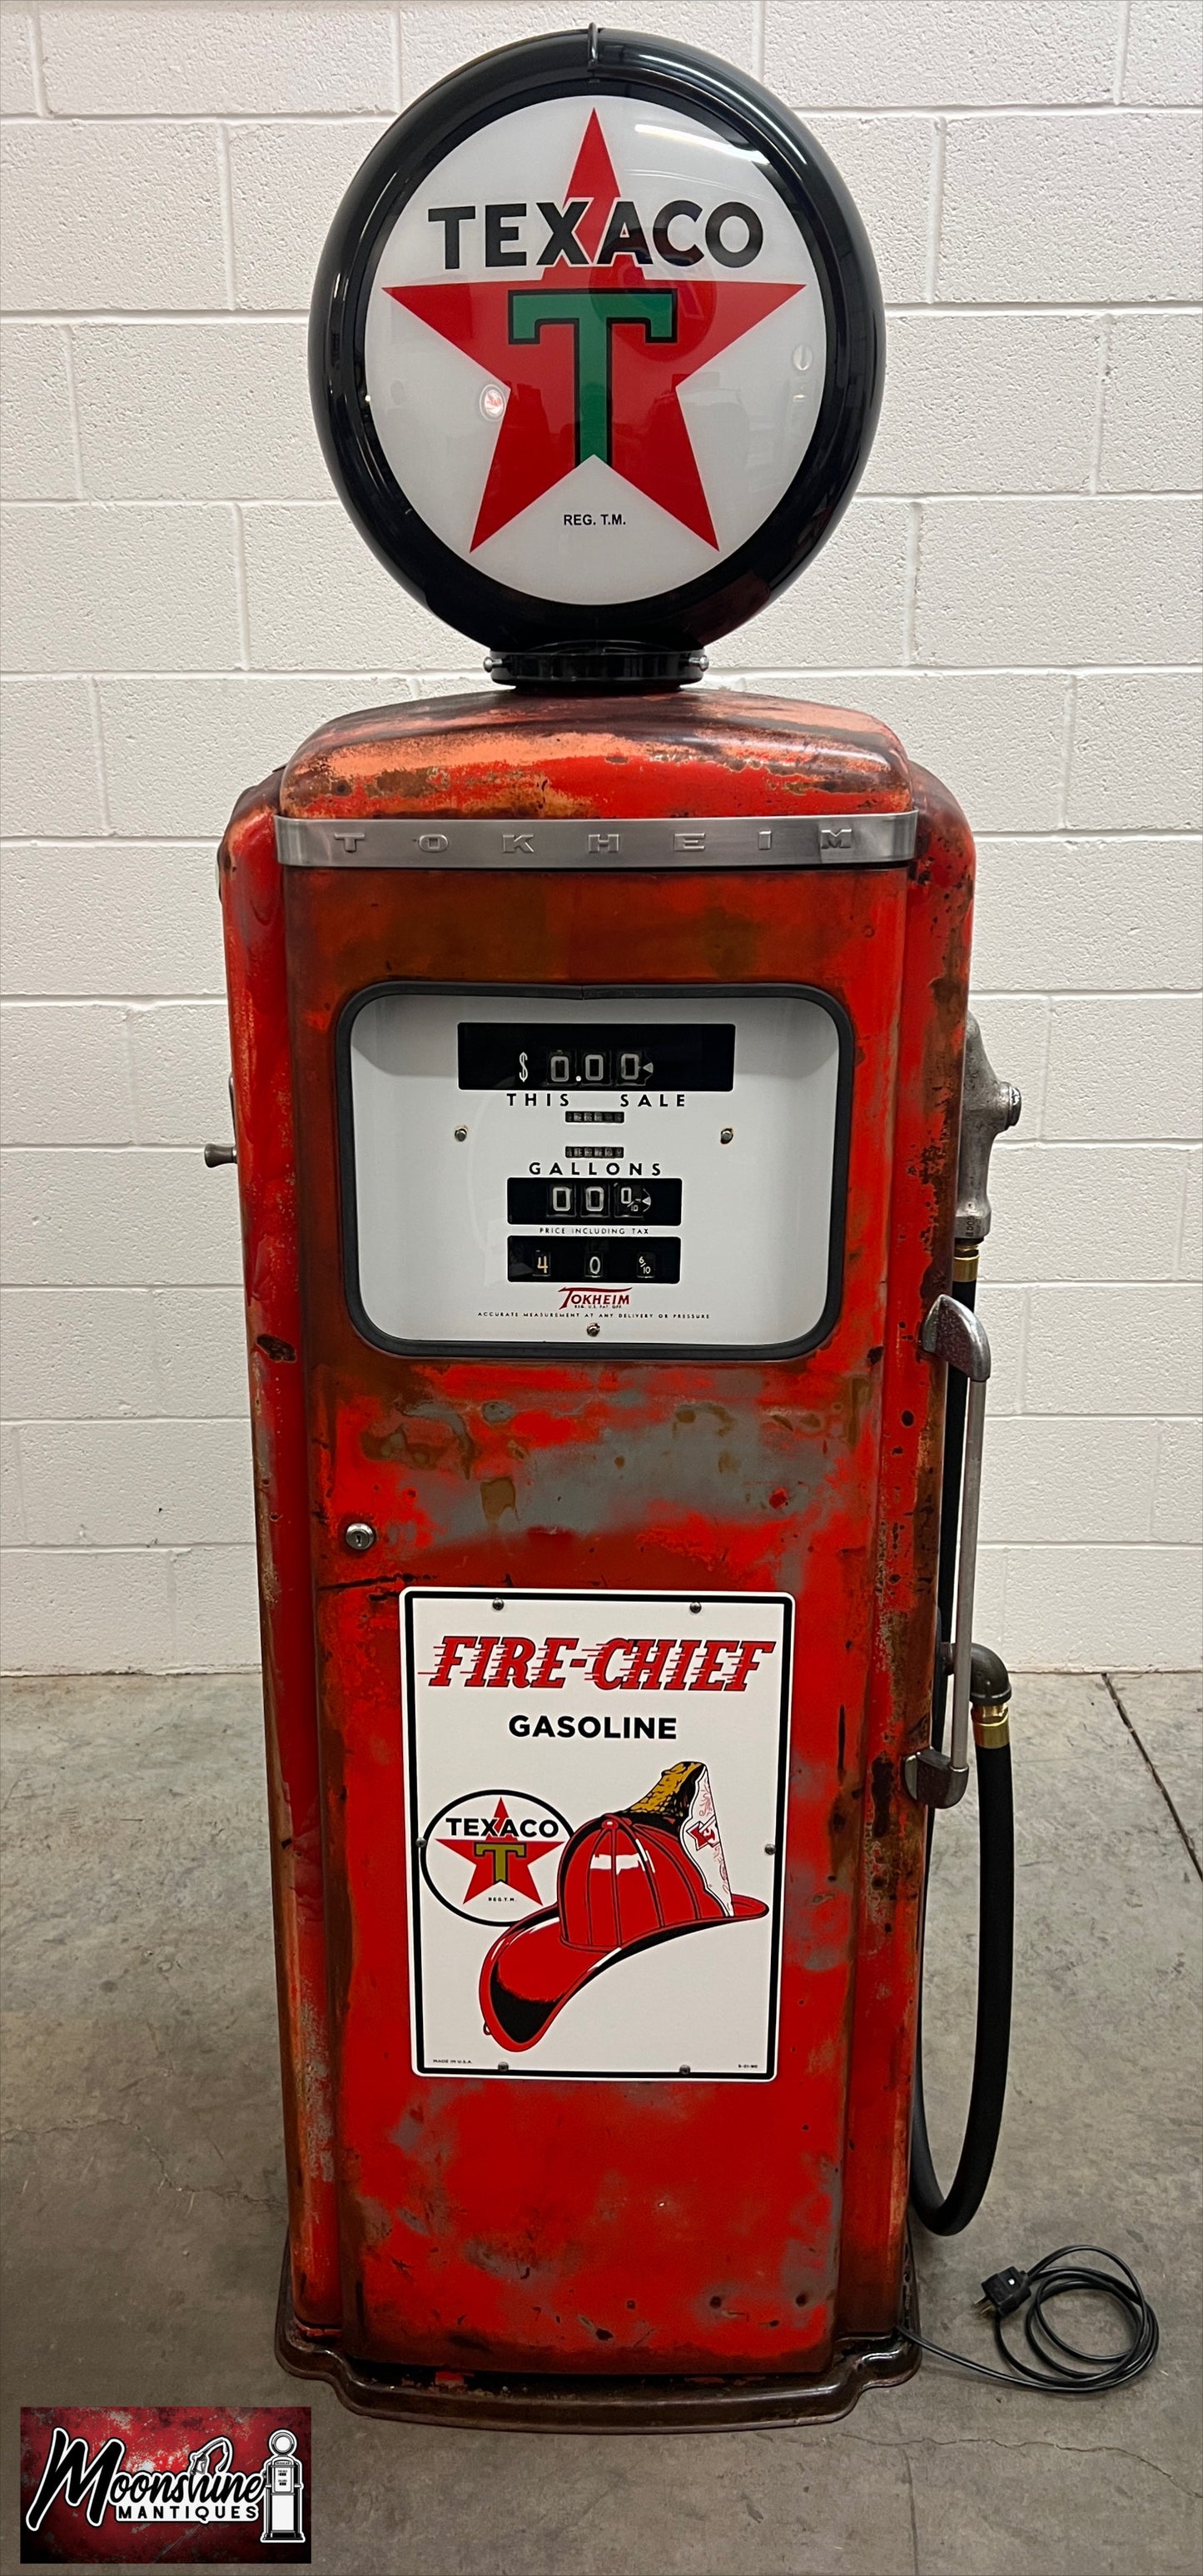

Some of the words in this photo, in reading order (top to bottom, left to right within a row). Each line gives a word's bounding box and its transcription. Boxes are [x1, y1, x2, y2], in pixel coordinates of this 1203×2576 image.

[427, 200, 763, 271] TEXACO
[508, 288, 679, 469] T
[564, 514, 596, 525] REG.
[600, 514, 626, 525] T.M.
[334, 828, 853, 853] TOKHEIM
[519, 1052, 528, 1082] $
[507, 1093, 569, 1107] THIS
[619, 1093, 686, 1108] SALE
[529, 1161, 661, 1176] GALLONS
[537, 1256, 549, 1273] 4
[589, 1256, 600, 1274] 0
[558, 1286, 633, 1310] TOKHEIM
[419, 1635, 776, 1692] FIRE-CHIEF
[509, 1715, 677, 1739] GASOLINE
[445, 1818, 559, 1838] TEXACO
[474, 1841, 527, 1885] T
